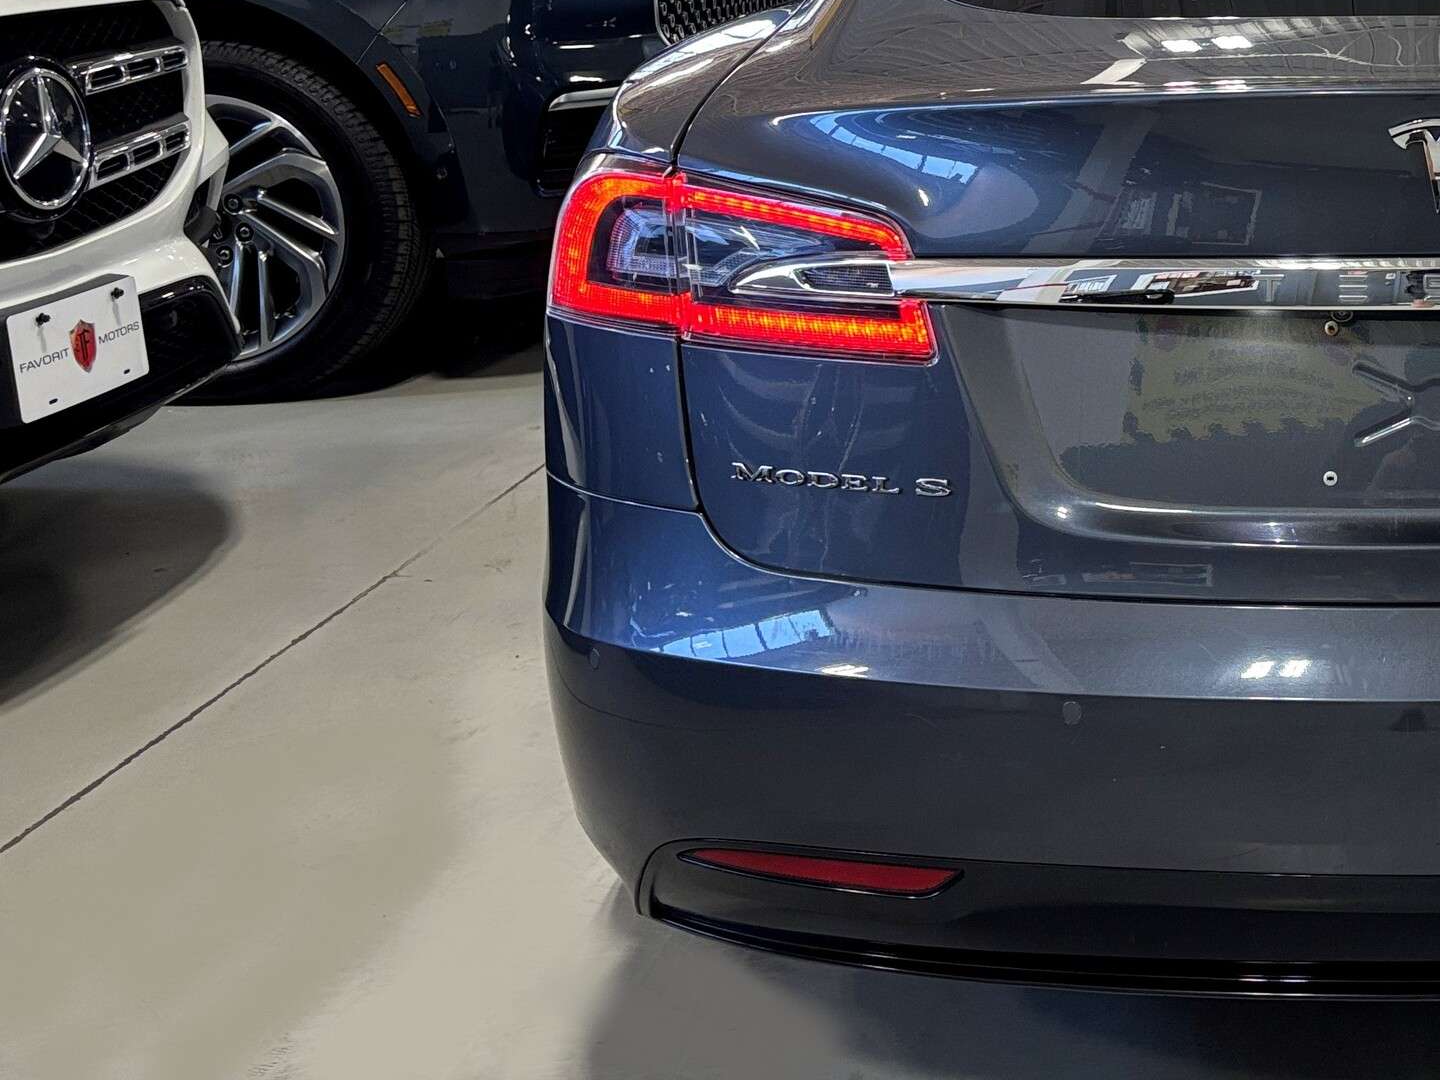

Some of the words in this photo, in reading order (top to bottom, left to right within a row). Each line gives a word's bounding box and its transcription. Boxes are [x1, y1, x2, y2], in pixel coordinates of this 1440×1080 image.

[19, 347, 69, 373] FAVORIT
[98, 321, 140, 344] MOTORS
[731, 462, 900, 494] MODEL
[915, 478, 952, 497] S
